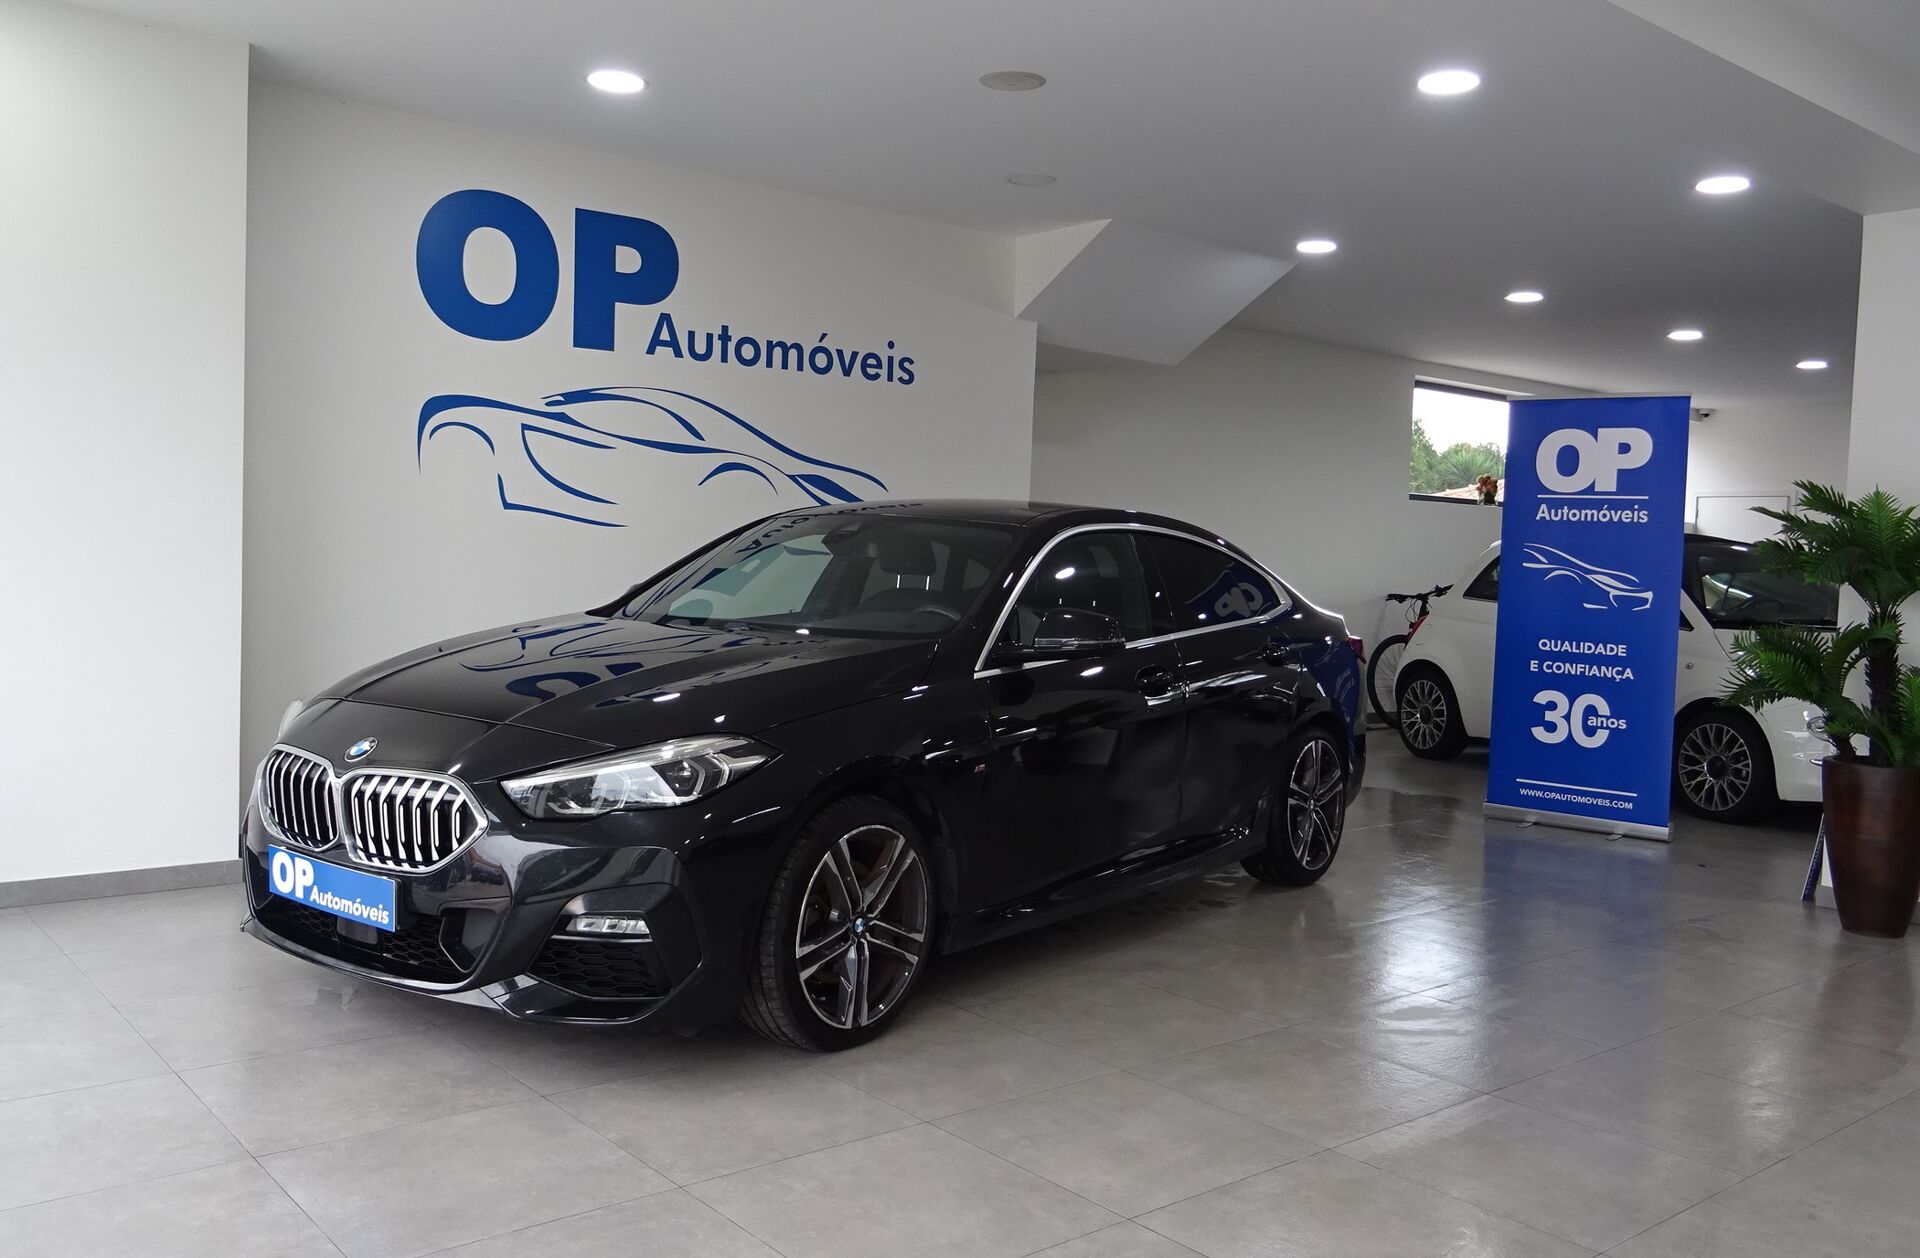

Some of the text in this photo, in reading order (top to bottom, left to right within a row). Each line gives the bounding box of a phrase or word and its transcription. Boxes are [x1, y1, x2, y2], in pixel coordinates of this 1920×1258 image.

[416, 188, 915, 386] OP Automóveis
[1535, 427, 1653, 493] OP
[1535, 503, 1649, 524] Automóveis
[1538, 638, 1627, 657] QUALIDADE
[1530, 660, 1634, 682] E CONFIANÇA
[1530, 689, 1627, 749] 30 anos
[1519, 787, 1633, 810] WWW.OPAUTOMOVEIS.COM
[272, 850, 390, 925] OP Automóveis
